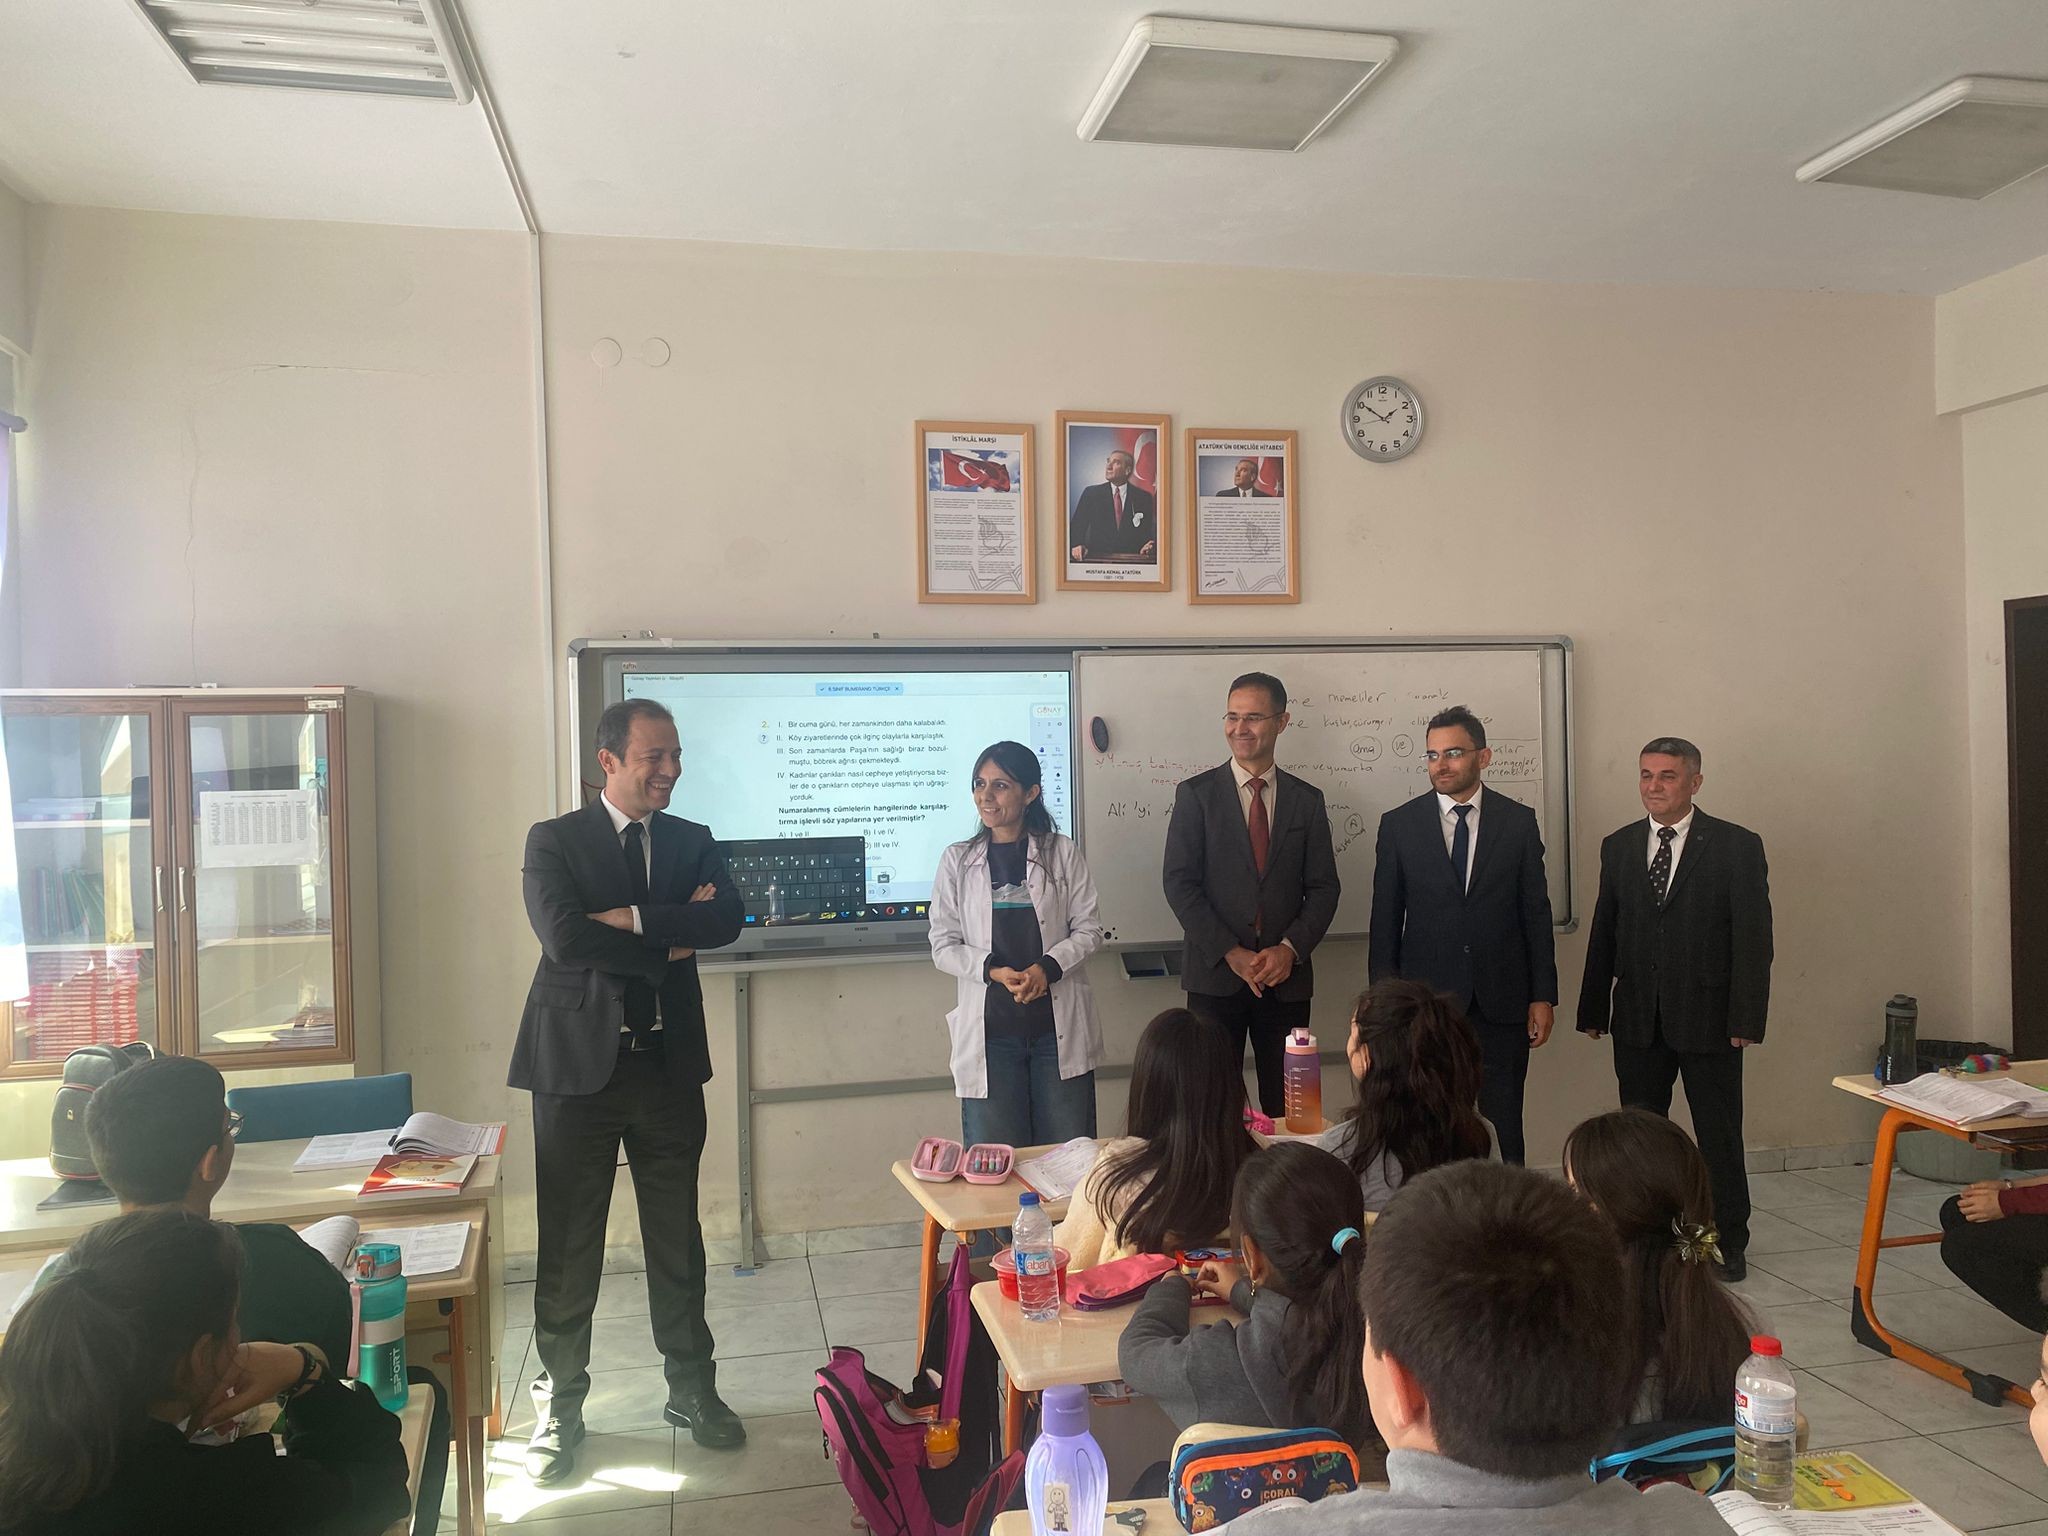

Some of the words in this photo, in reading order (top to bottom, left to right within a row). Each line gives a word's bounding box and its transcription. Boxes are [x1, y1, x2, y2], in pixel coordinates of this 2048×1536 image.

[1378, 386, 1387, 394] 12
[1356, 401, 1365, 409] 10
[1402, 401, 1409, 409] 2
[1353, 415, 1360, 423] 9
[1406, 415, 1413, 423] 3
[1357, 429, 1365, 438] 8
[1402, 430, 1409, 438] 4
[1367, 440, 1374, 448] 7
[1380, 444, 1388, 452] 6
[1393, 440, 1401, 448] 5
[788, 734, 802, 743] Köy
[863, 733, 881, 742] ilginç
[881, 733, 910, 741] olaylarla
[788, 747, 803, 755] Son
[789, 771, 818, 779] Kadınlar
[847, 770, 864, 778] nasıl
[864, 770, 894, 778] cepheye
[850, 782, 880, 790] cepheye
[881, 781, 911, 789] ulaşması
[913, 780, 925, 788] için
[833, 805, 871, 813] cümlelerin
[873, 804, 918, 812] hangilerinde
[919, 803, 950, 811] karşılaş-
[1108, 802, 1126, 817] Ali
[799, 817, 821, 826] işlevli
[836, 817, 872, 825] yapılarına
[885, 814, 926, 823] verilmiştir?
[863, 828, 871, 837] B)
[393, 1347, 402, 1395] SPORT
[1263, 1487, 1298, 1499] CORAL
